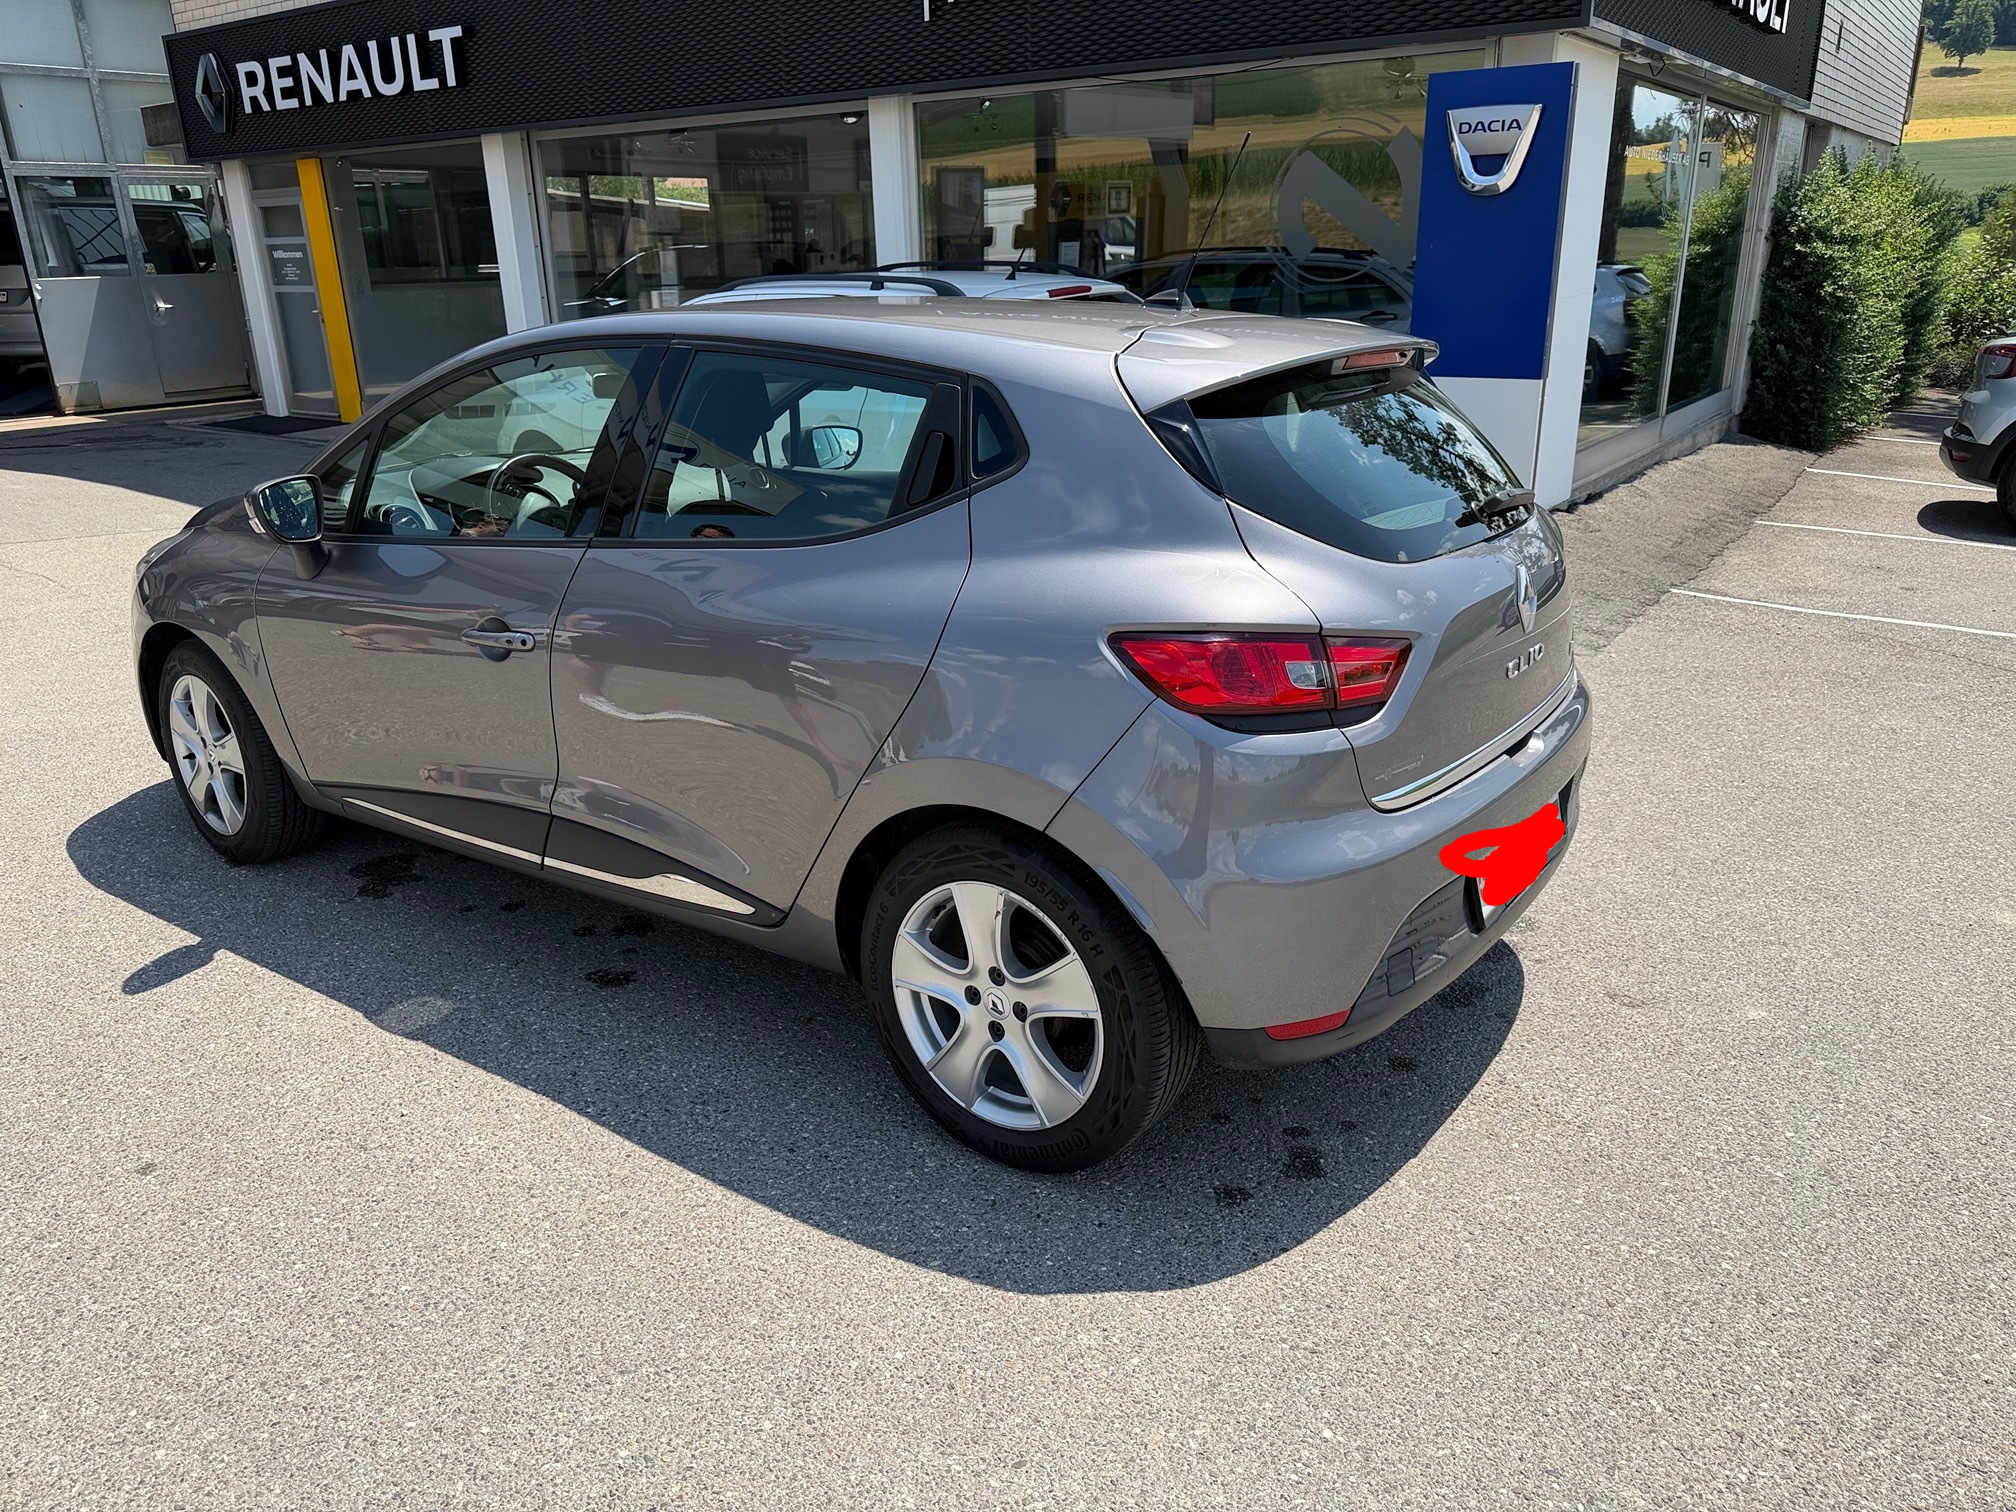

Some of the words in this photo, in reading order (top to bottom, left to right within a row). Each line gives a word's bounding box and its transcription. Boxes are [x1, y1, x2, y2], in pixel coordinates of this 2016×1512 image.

[235, 25, 462, 114] RENAULT
[1458, 118, 1522, 135] DACIA
[1506, 642, 1545, 679] CLIO
[1024, 871, 1069, 912] 195/55
[1067, 910, 1080, 927] R
[1077, 923, 1094, 941] 16
